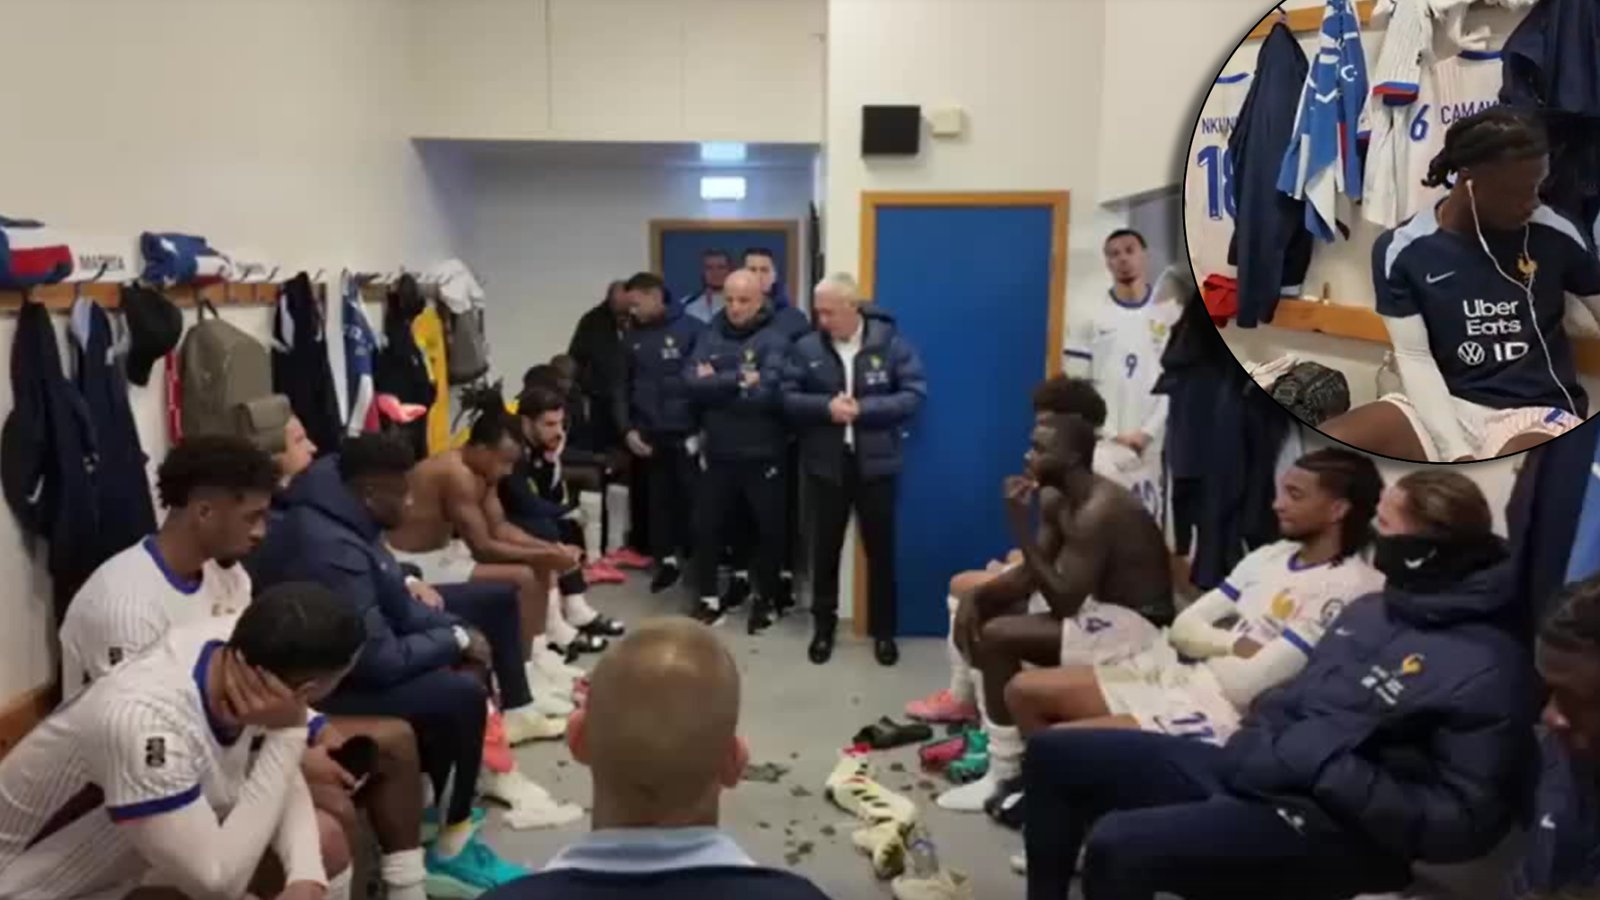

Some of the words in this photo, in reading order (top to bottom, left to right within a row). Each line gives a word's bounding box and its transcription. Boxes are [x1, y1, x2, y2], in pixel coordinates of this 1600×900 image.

[1410, 104, 1430, 142] 6
[1463, 299, 1519, 317] Uber
[1466, 319, 1521, 336] Eats
[1493, 342, 1529, 361] ID
[1125, 353, 1138, 379] 9
